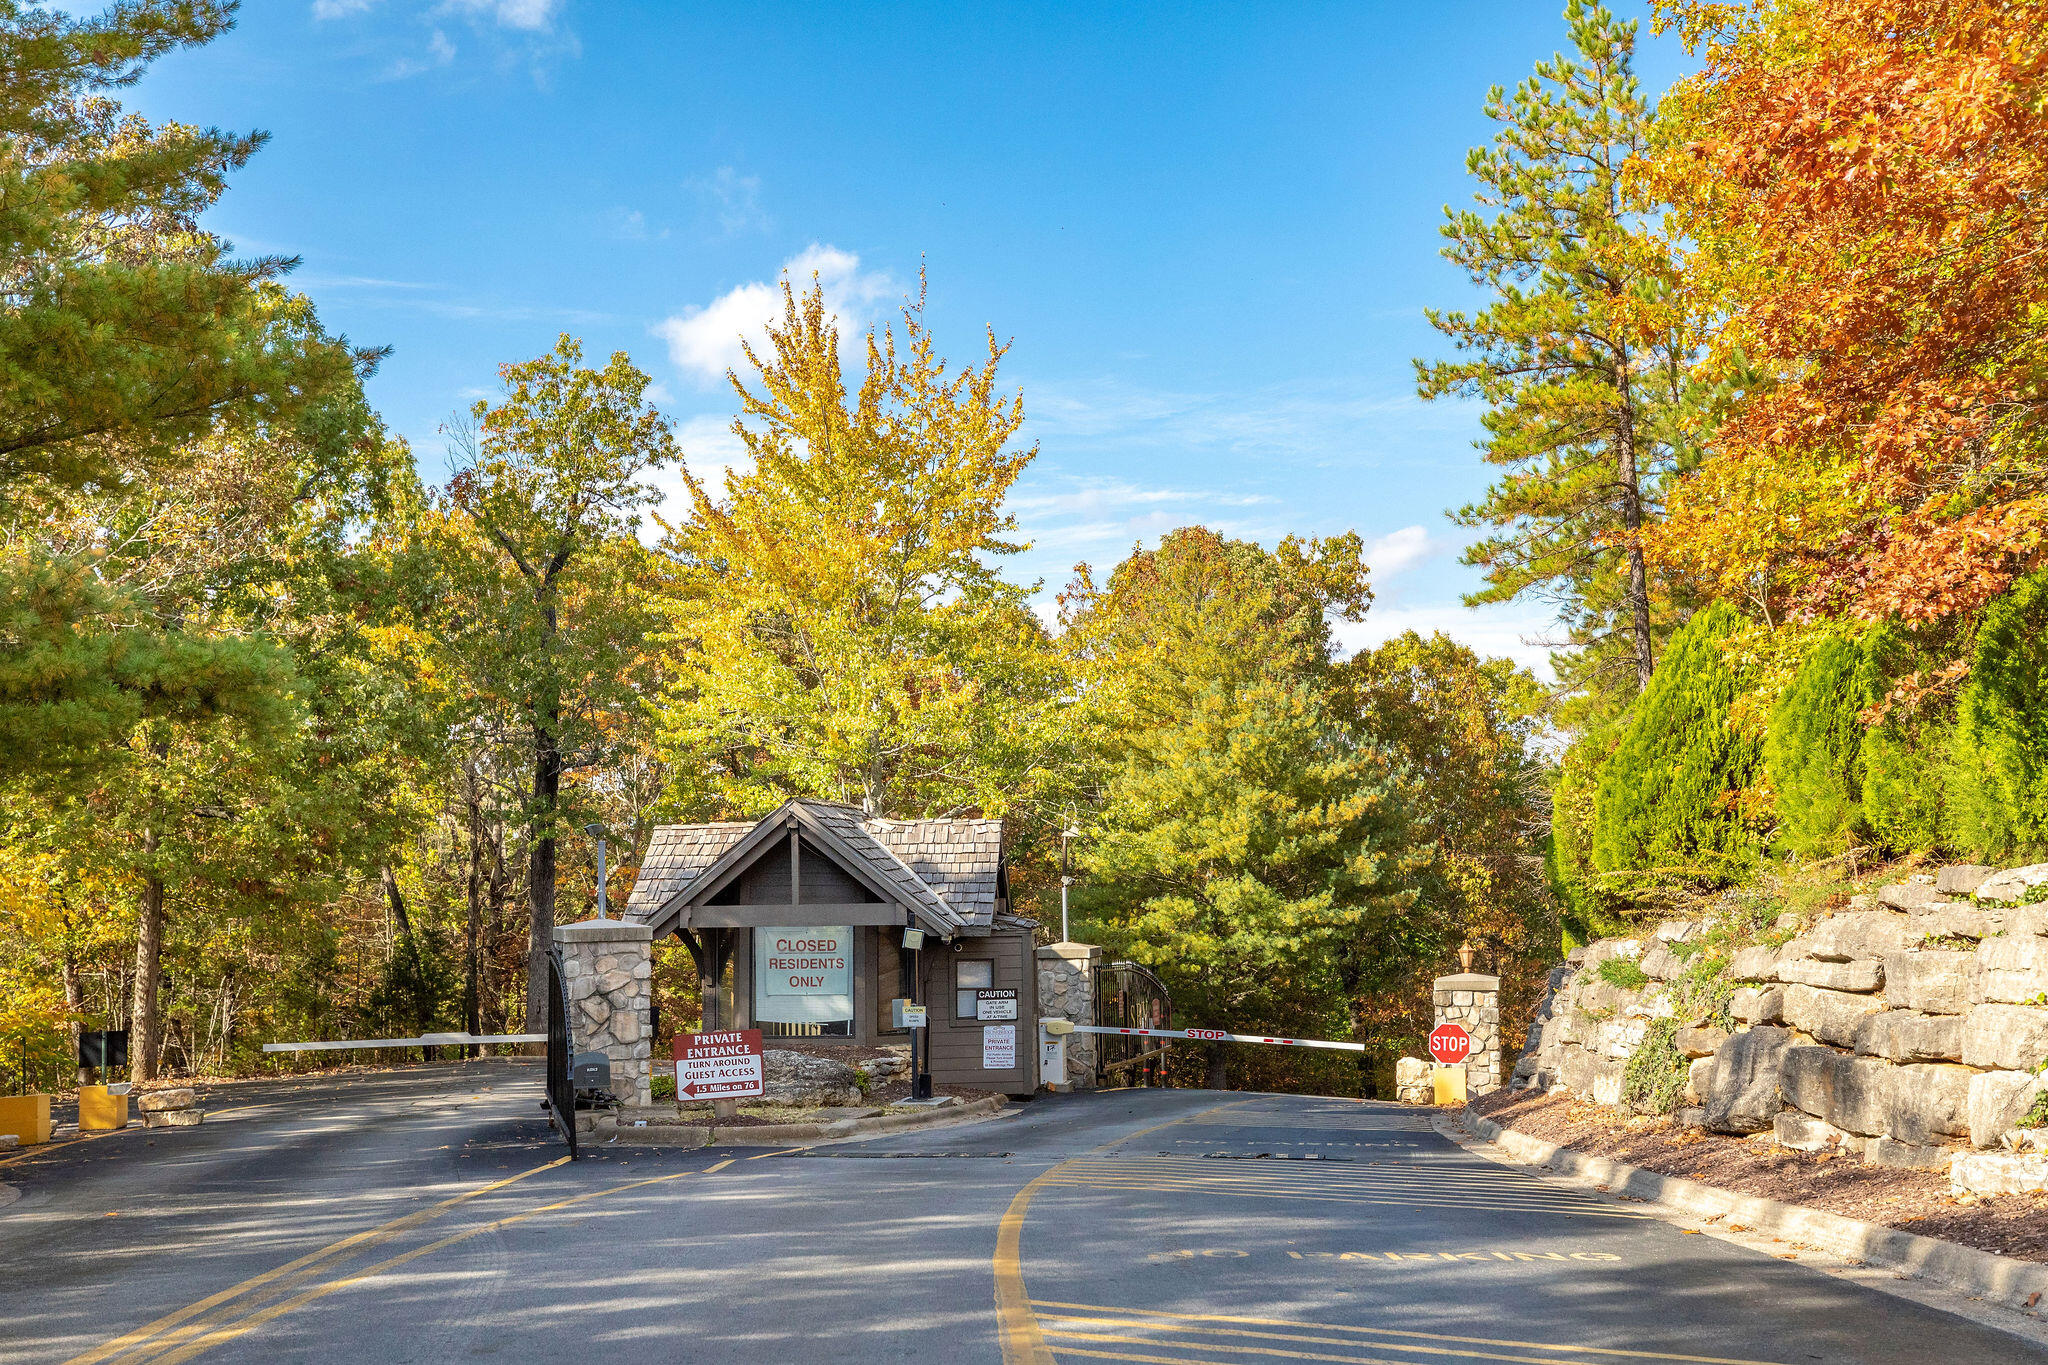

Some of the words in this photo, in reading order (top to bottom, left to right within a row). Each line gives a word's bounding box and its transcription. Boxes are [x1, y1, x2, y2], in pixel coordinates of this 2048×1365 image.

[776, 939, 837, 952] CLOSED
[769, 958, 845, 969] RESIDENTS
[789, 976, 824, 987] ONLY
[978, 990, 1015, 998] CAUTION
[694, 1032, 743, 1046] PRIVATE
[1187, 1029, 1225, 1039] STOP
[1432, 1035, 1468, 1052] STOP
[687, 1044, 751, 1059] ENTRANCE
[688, 1060, 711, 1069] TURN
[713, 1057, 750, 1067] AROUND
[685, 1071, 716, 1080] GUEST
[718, 1067, 755, 1078] ACCESS
[696, 1084, 707, 1093] 1.5
[709, 1083, 731, 1092] Miles
[744, 1081, 755, 1089] 76
[1286, 1251, 1623, 1262] PARKING
